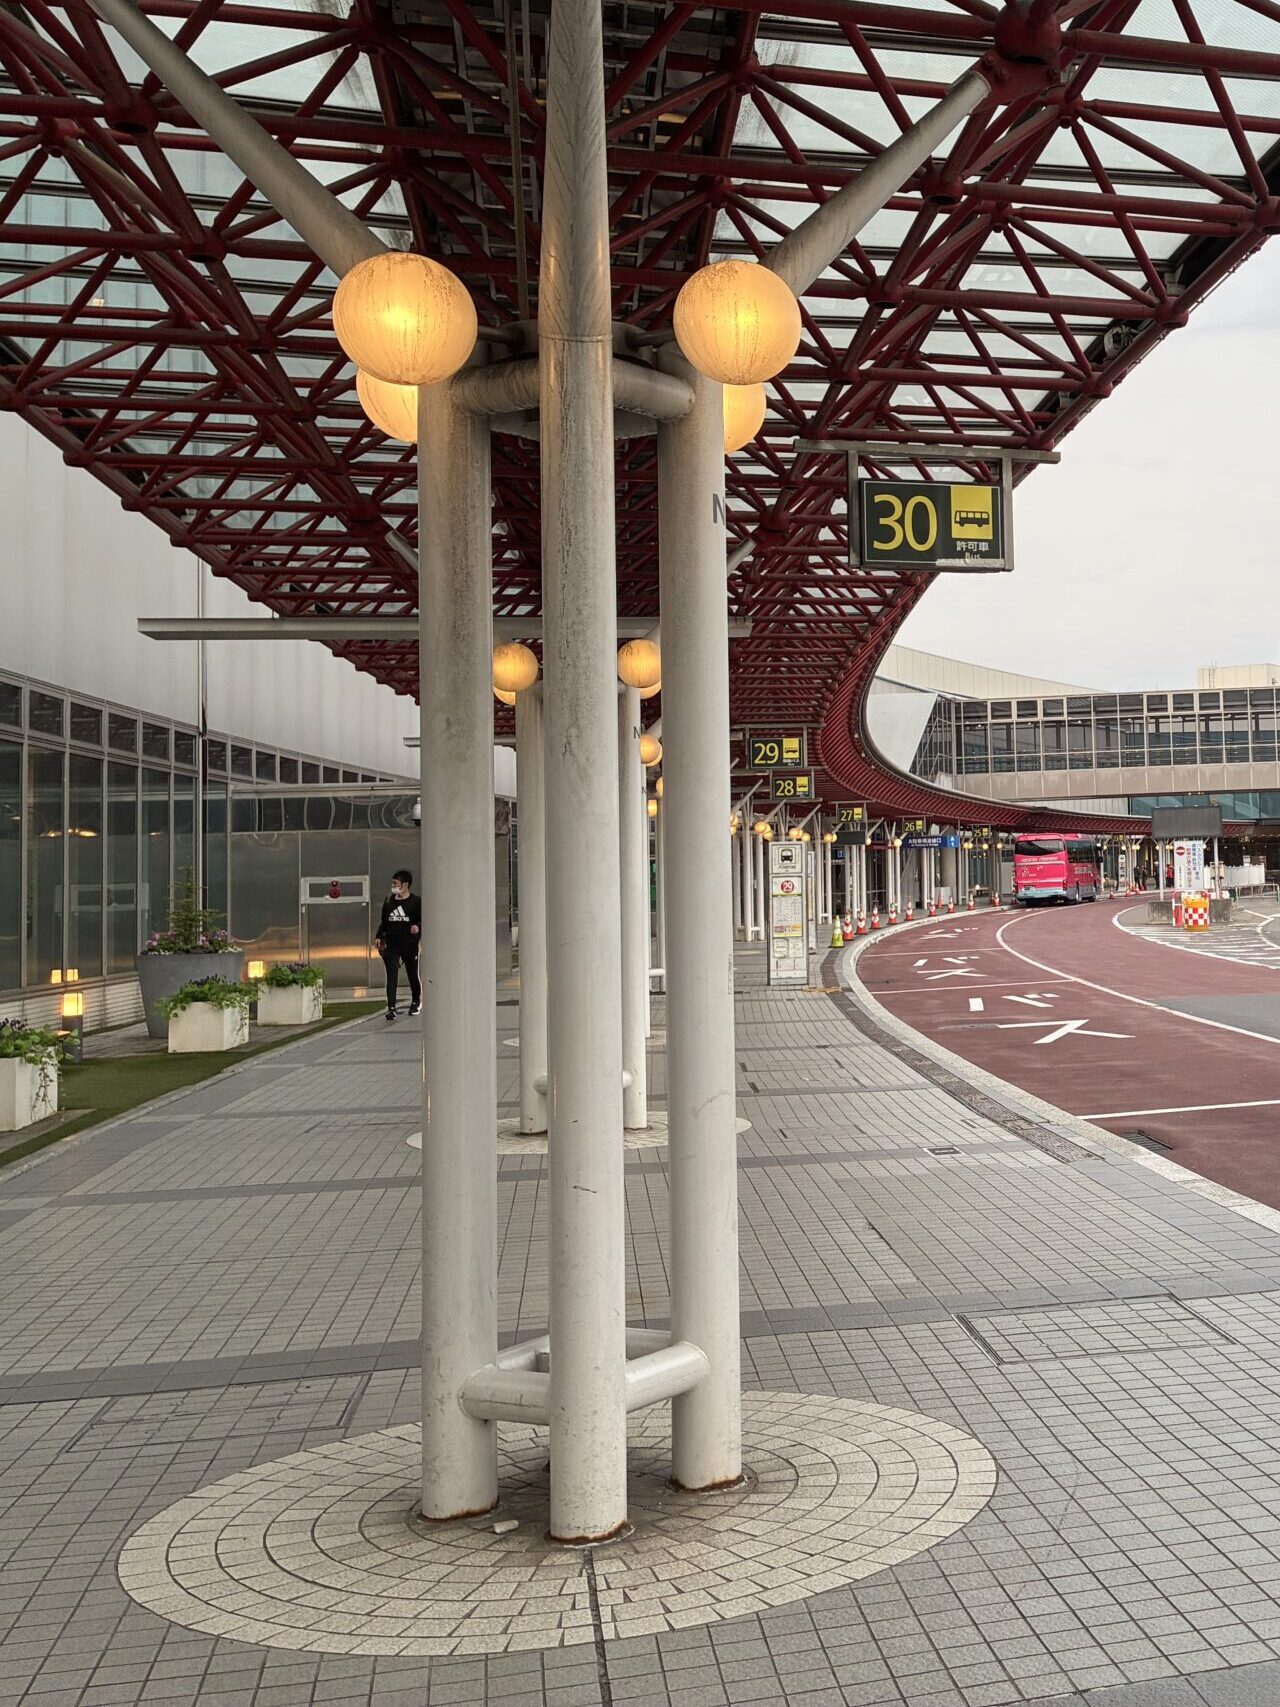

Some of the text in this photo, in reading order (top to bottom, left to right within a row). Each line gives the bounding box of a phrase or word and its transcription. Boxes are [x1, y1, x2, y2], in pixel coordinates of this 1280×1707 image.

[873, 494, 938, 551] 30
[956, 541, 990, 552] 許可車
[754, 743, 779, 764] 29
[775, 780, 794, 796] 28
[840, 811, 853, 822] 27
[904, 822, 915, 832] 26
[973, 829, 982, 837] 25
[782, 882, 793, 891] 29
[968, 993, 1137, 1045] バス
